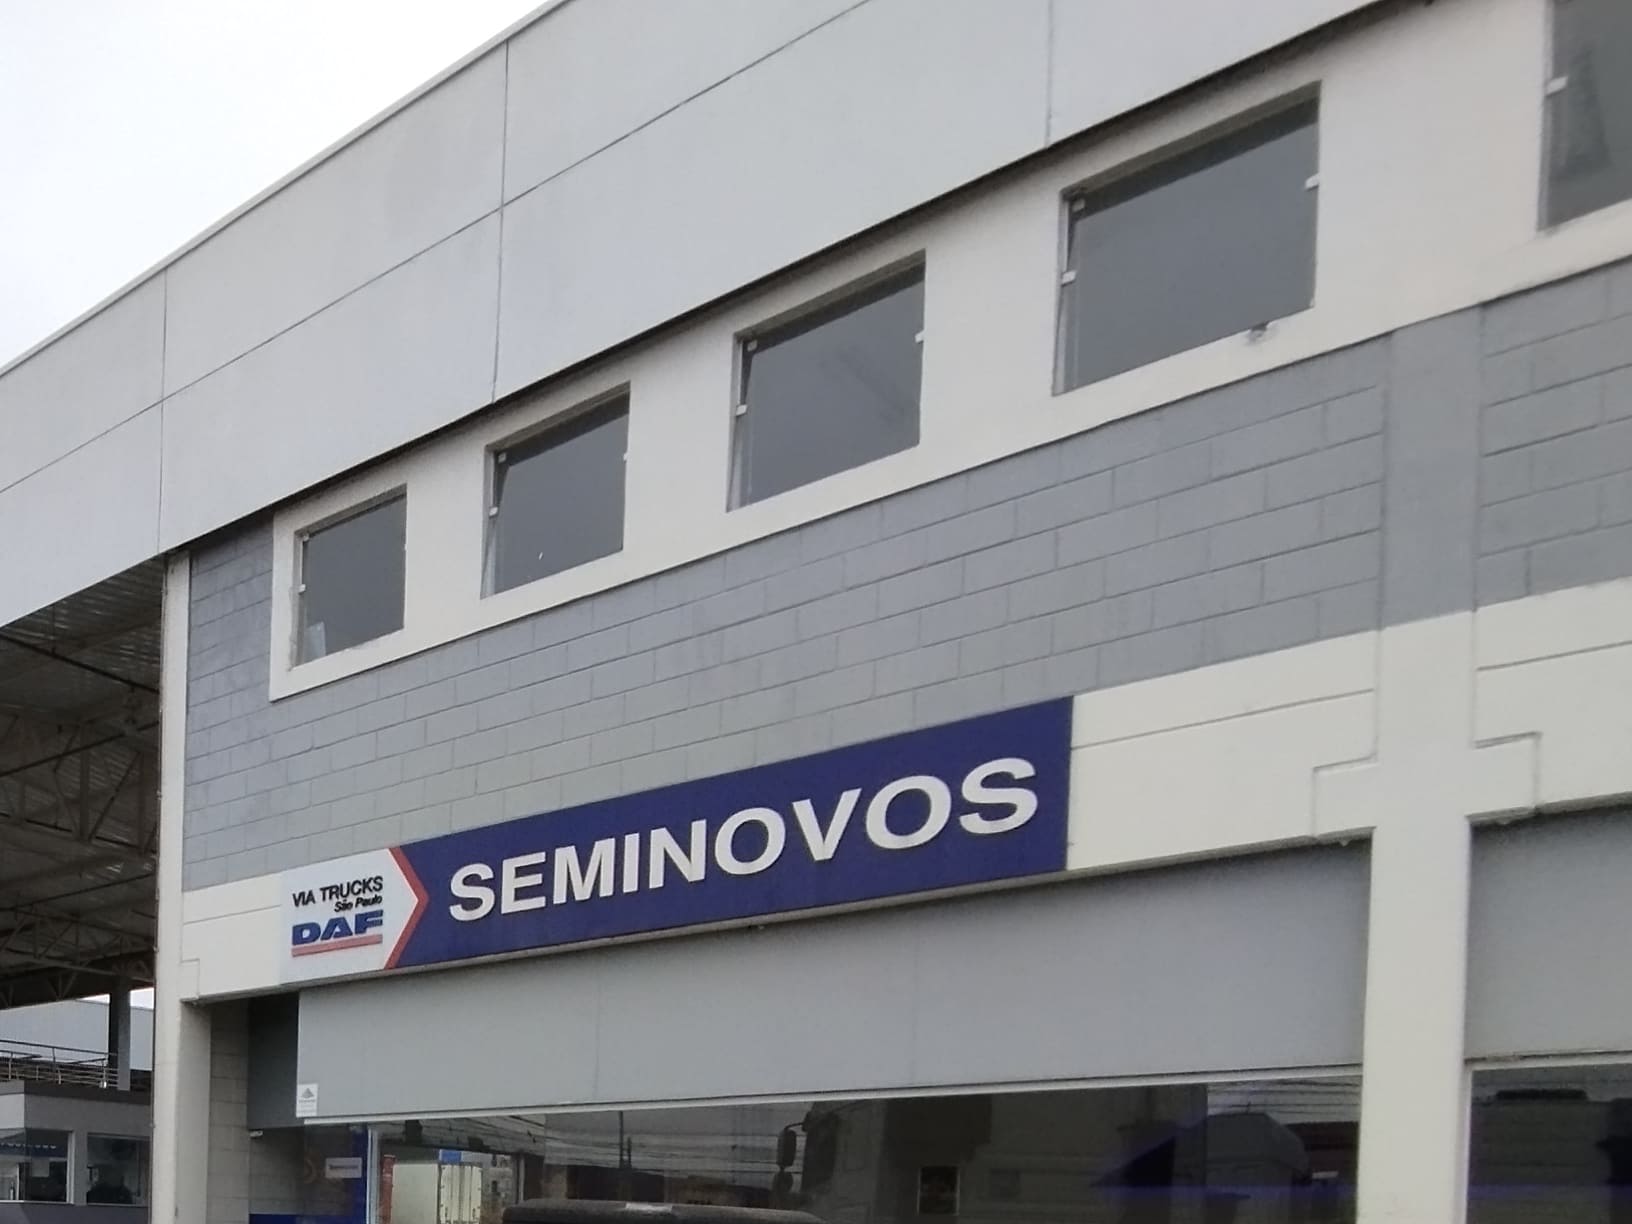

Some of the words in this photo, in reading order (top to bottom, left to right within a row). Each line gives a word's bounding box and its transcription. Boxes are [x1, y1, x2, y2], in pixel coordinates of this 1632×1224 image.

[449, 757, 1040, 921] SEMINOVOS
[291, 891, 316, 908] VIA
[319, 876, 384, 901] TRUCKS
[354, 894, 383, 909] Paulo
[291, 909, 384, 946] DAF
